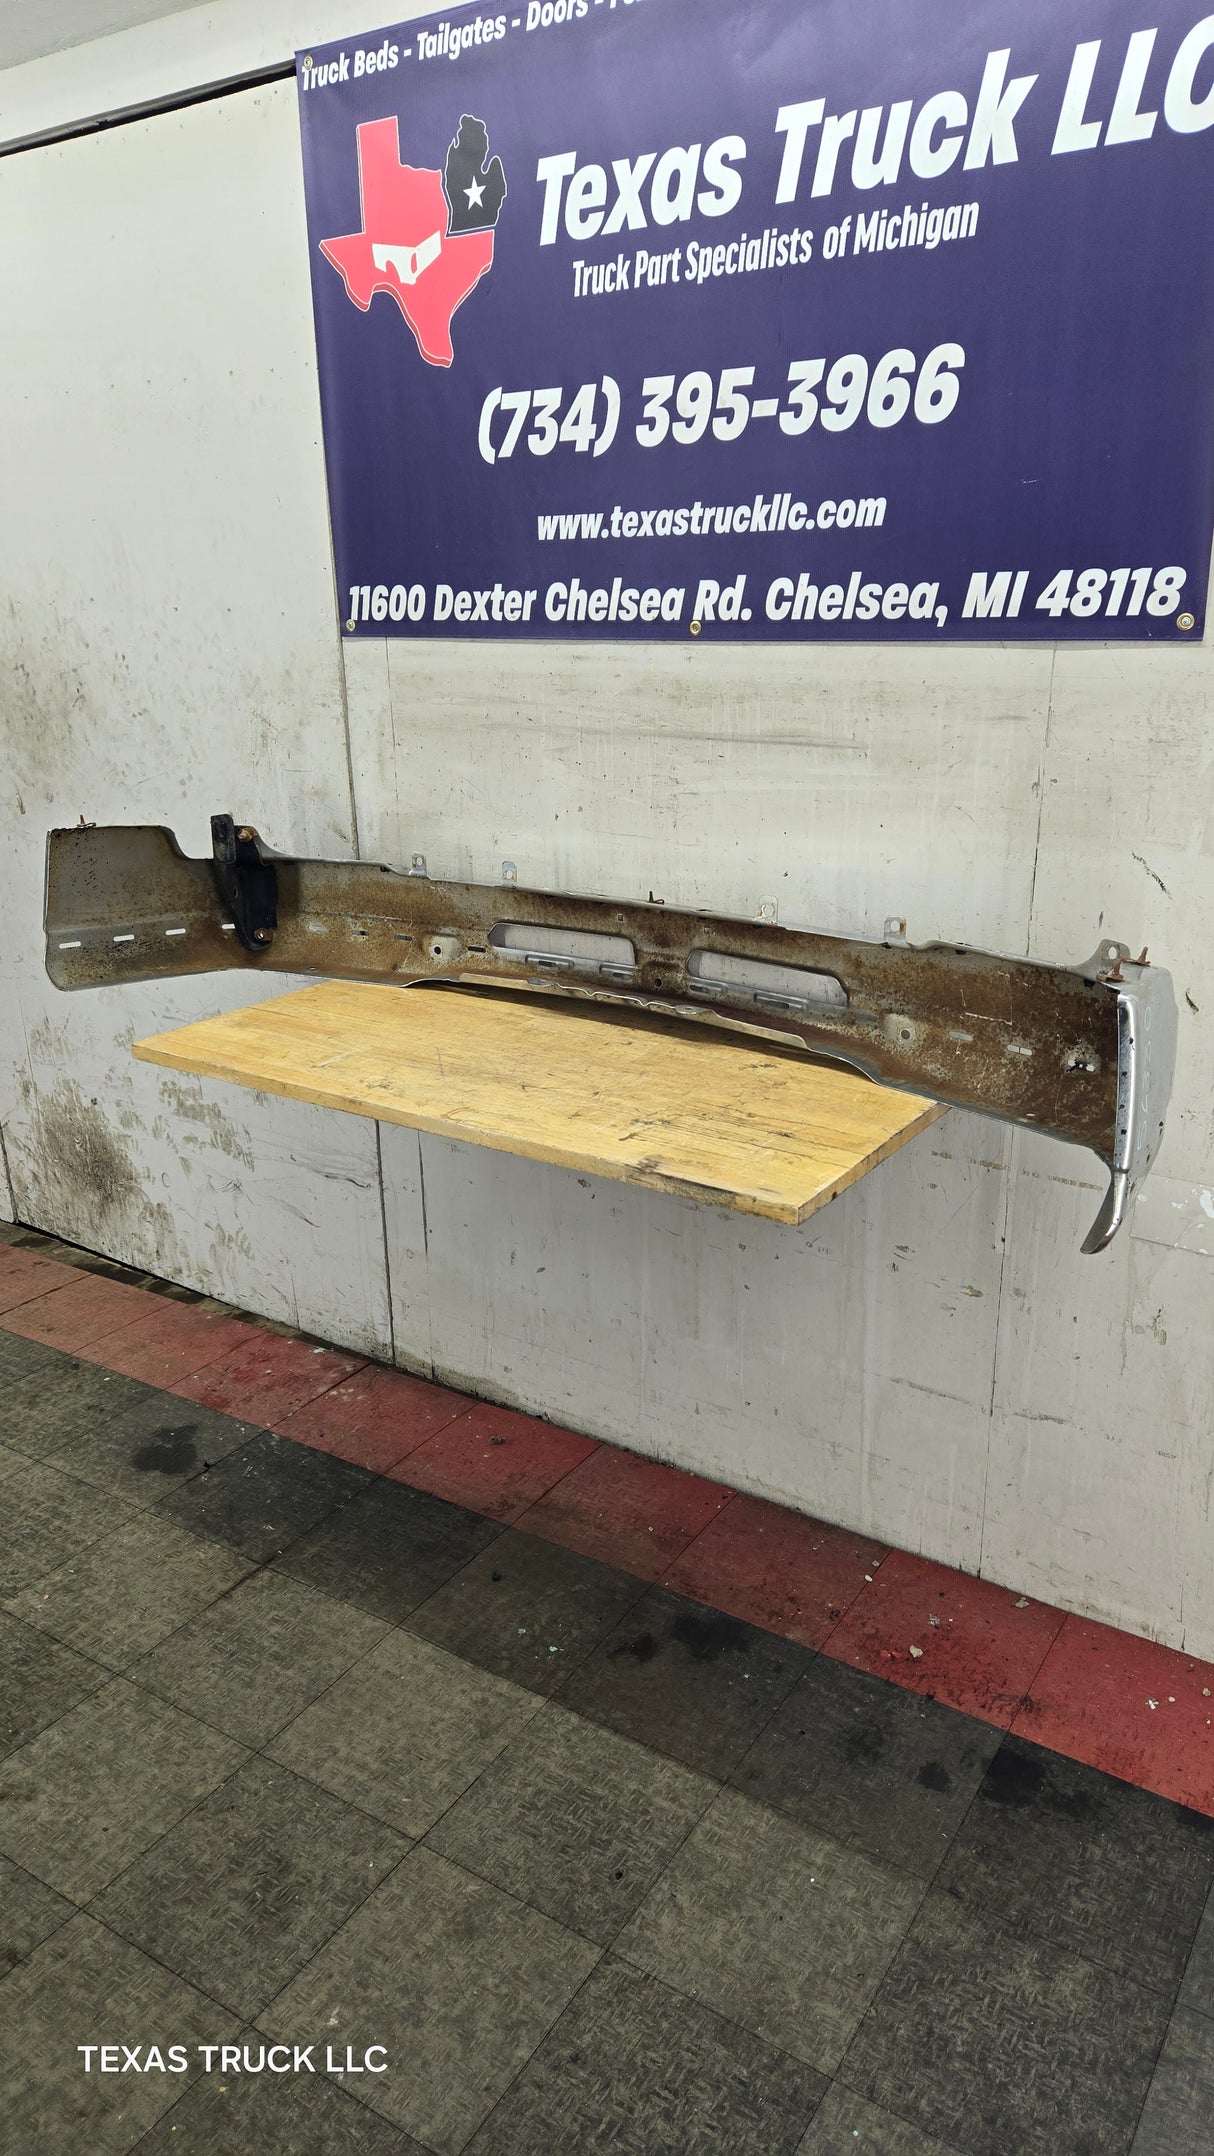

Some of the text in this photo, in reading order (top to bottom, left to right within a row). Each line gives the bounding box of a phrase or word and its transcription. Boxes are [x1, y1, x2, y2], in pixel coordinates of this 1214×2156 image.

[301, 53, 350, 91] Truck
[353, 40, 399, 77] Beds
[417, 15, 506, 60] Tailgates
[526, 0, 589, 32] Doors
[536, 135, 747, 246] Texas
[774, 48, 1039, 205] Truck
[572, 201, 980, 297] Truck Part Specialists of Michigan
[478, 343, 965, 464] (734) 395-3966
[537, 493, 887, 541] www.texastruckllc.com
[349, 566, 1187, 628] 11600 Dexter Chelsea Rd. Chelsea, MI 48118
